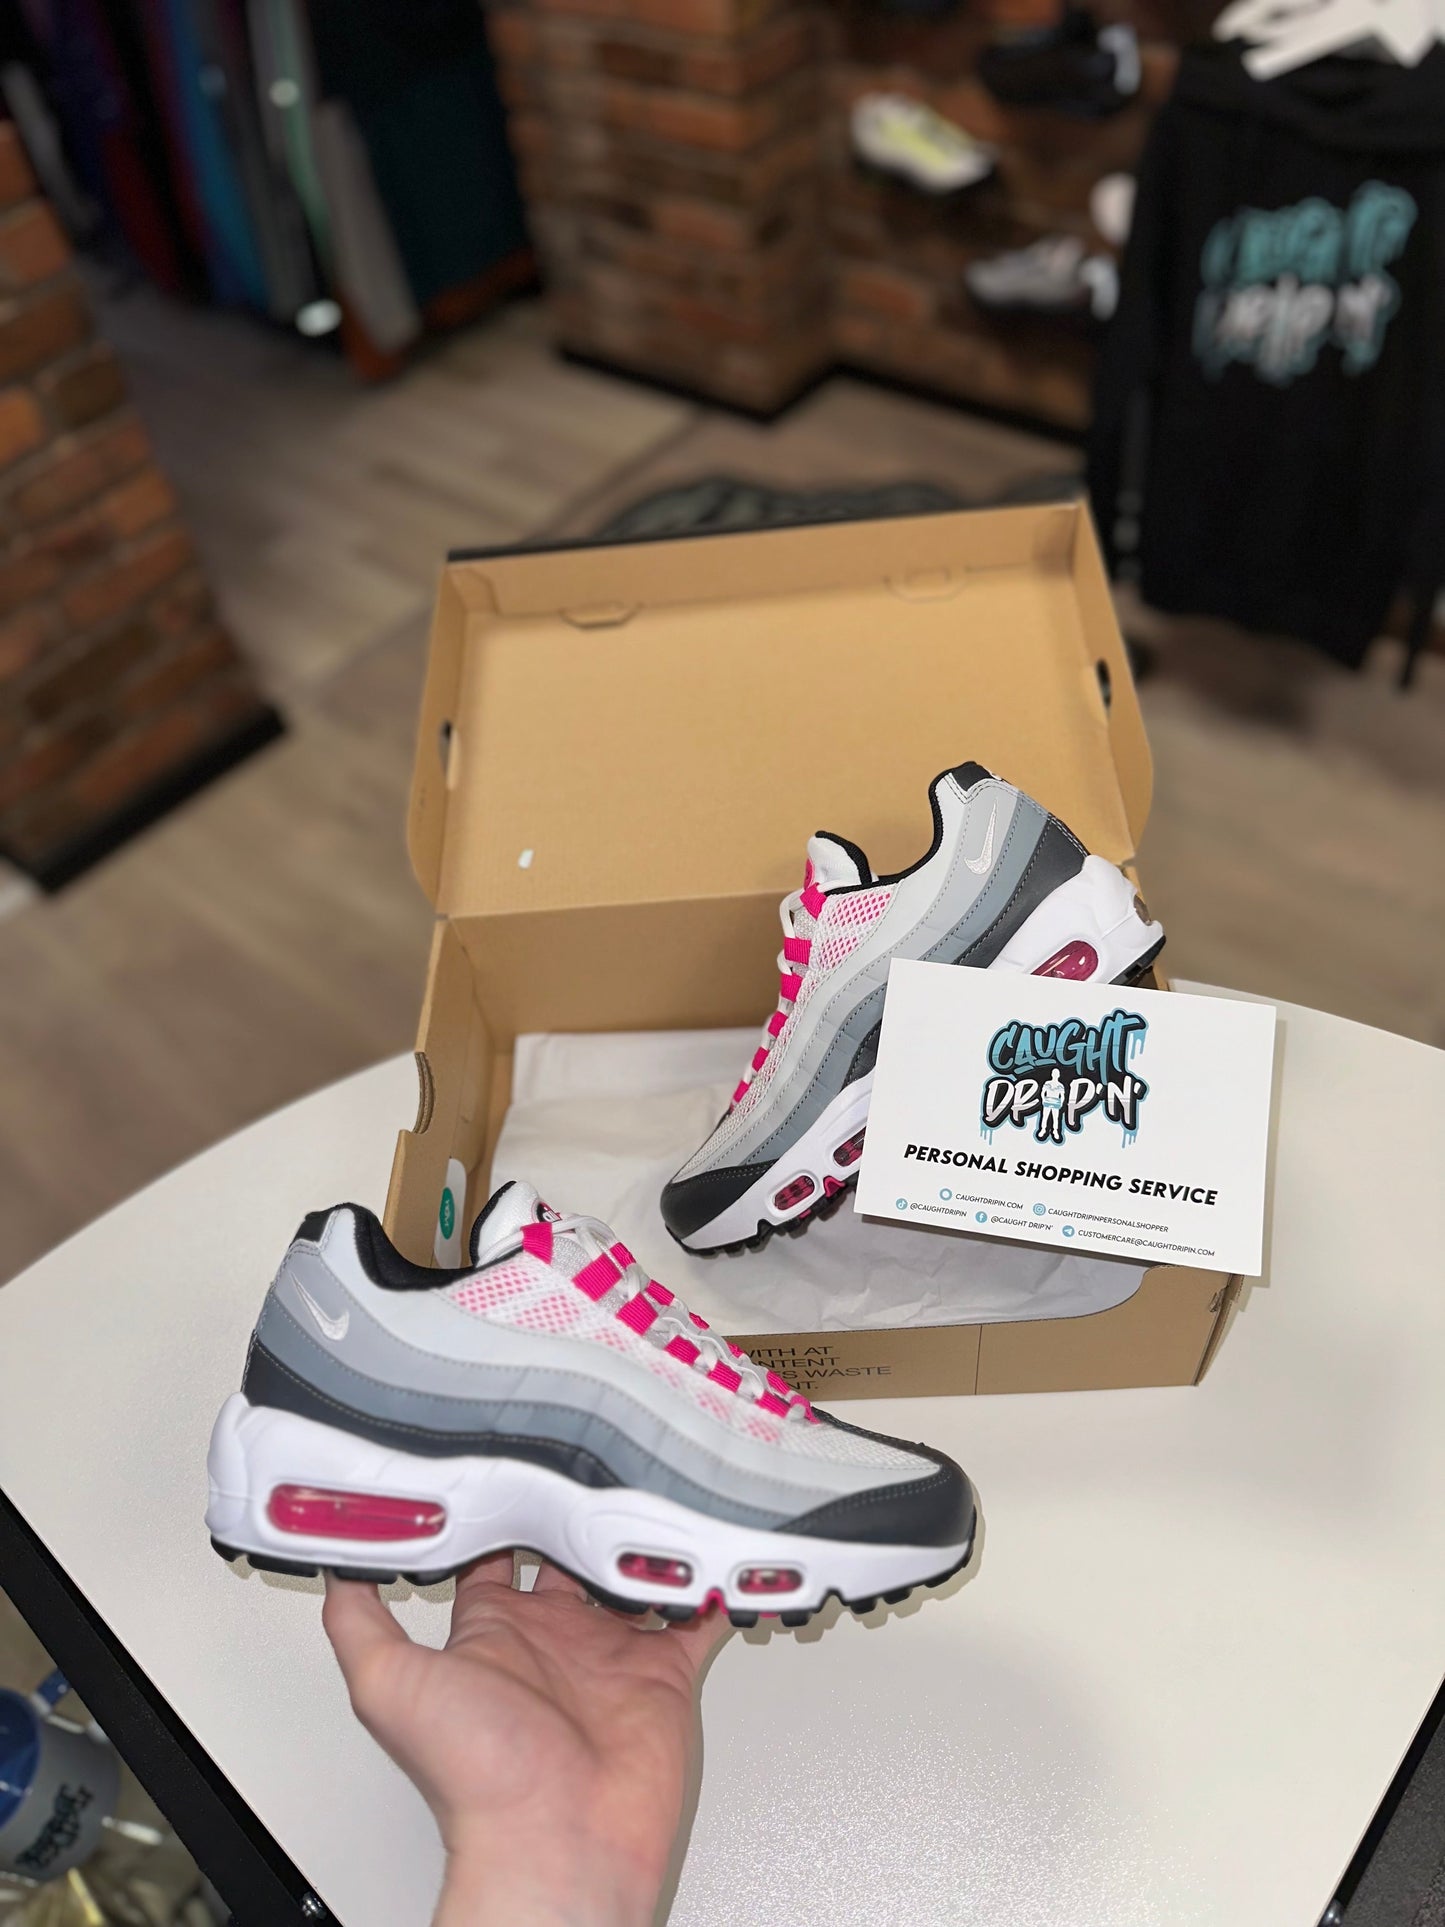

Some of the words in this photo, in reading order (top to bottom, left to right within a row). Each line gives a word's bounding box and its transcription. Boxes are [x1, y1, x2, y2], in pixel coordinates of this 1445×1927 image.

[989, 1011, 1143, 1085] CAUGHT
[903, 1143, 1009, 1175] PERSONAL
[1014, 1160, 1123, 1191] SHOPPING
[1128, 1178, 1218, 1206] SERVICE
[910, 1202, 968, 1218] @CAUGHTDRIPIN
[955, 1193, 1024, 1210] CAUGHTDRIPIN.COM
[990, 1215, 1027, 1227] @CAUGHT
[1047, 1207, 1169, 1233] CAUGHTDRIPINPERSONALSHOPPER
[1077, 1228, 1216, 1257] CUSTOMERCARE@CAUGHTDRIPIN.COM
[804, 1346, 834, 1356] AT
[804, 1366, 893, 1379] WASTE
